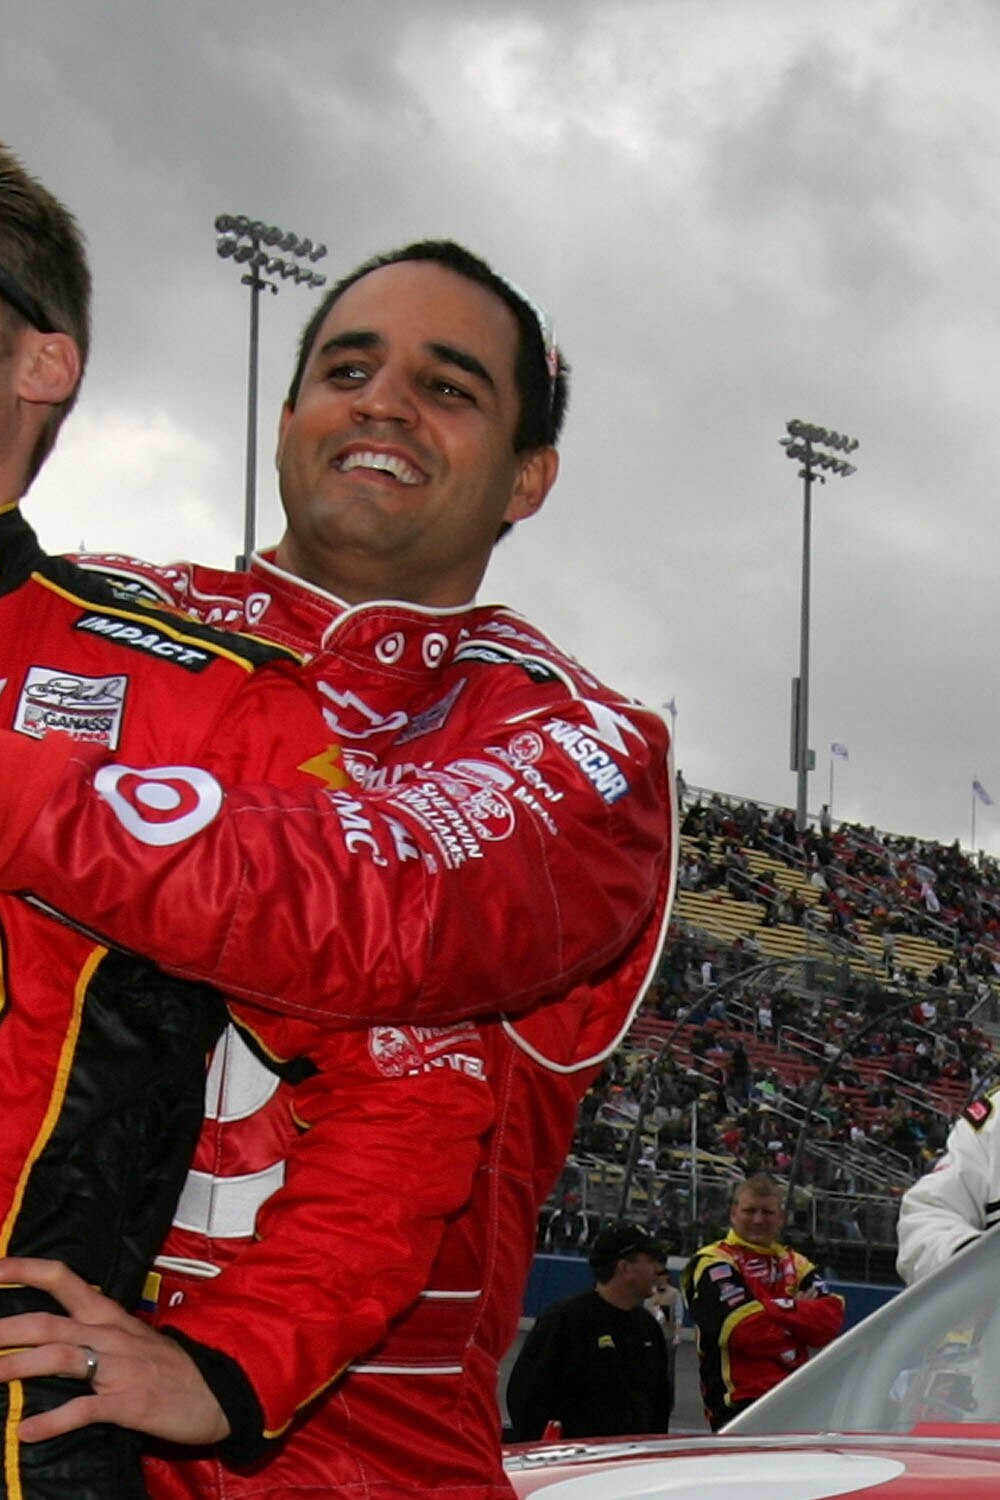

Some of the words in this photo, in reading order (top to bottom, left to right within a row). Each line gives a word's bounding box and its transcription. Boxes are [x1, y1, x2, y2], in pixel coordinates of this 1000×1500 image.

[76, 615, 207, 662] IMPACT
[541, 716, 629, 805] NASCAR
[396, 789, 467, 869] WILLIAMS
[421, 782, 484, 858] SHERWIN
